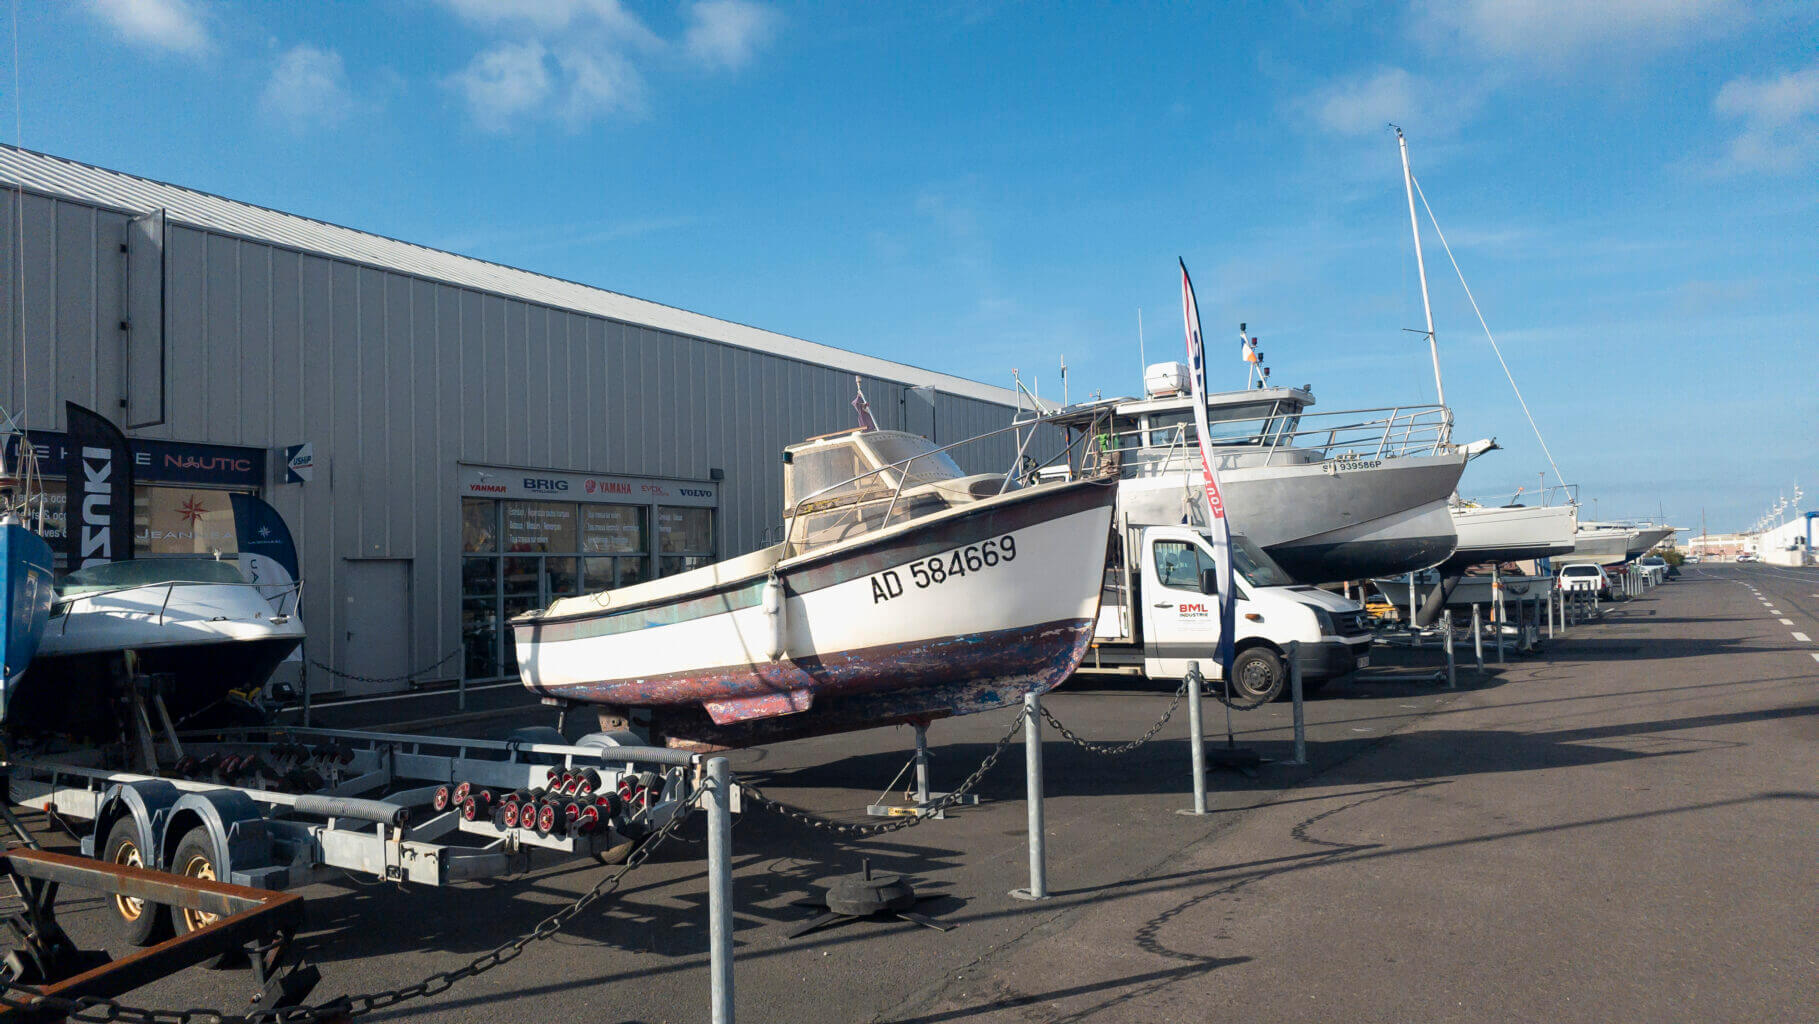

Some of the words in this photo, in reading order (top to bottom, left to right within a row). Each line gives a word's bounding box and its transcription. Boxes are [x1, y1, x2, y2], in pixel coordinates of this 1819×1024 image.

[1339, 460, 1382, 472] 939586P
[469, 484, 507, 493] YANMAR
[522, 478, 569, 491] BRIG
[600, 482, 632, 495] YAMAHA
[679, 488, 713, 498] VOLVO
[1204, 480, 1224, 515] TOUT
[870, 571, 904, 605] AD
[910, 535, 1017, 589] 584669
[1179, 603, 1209, 613] BML
